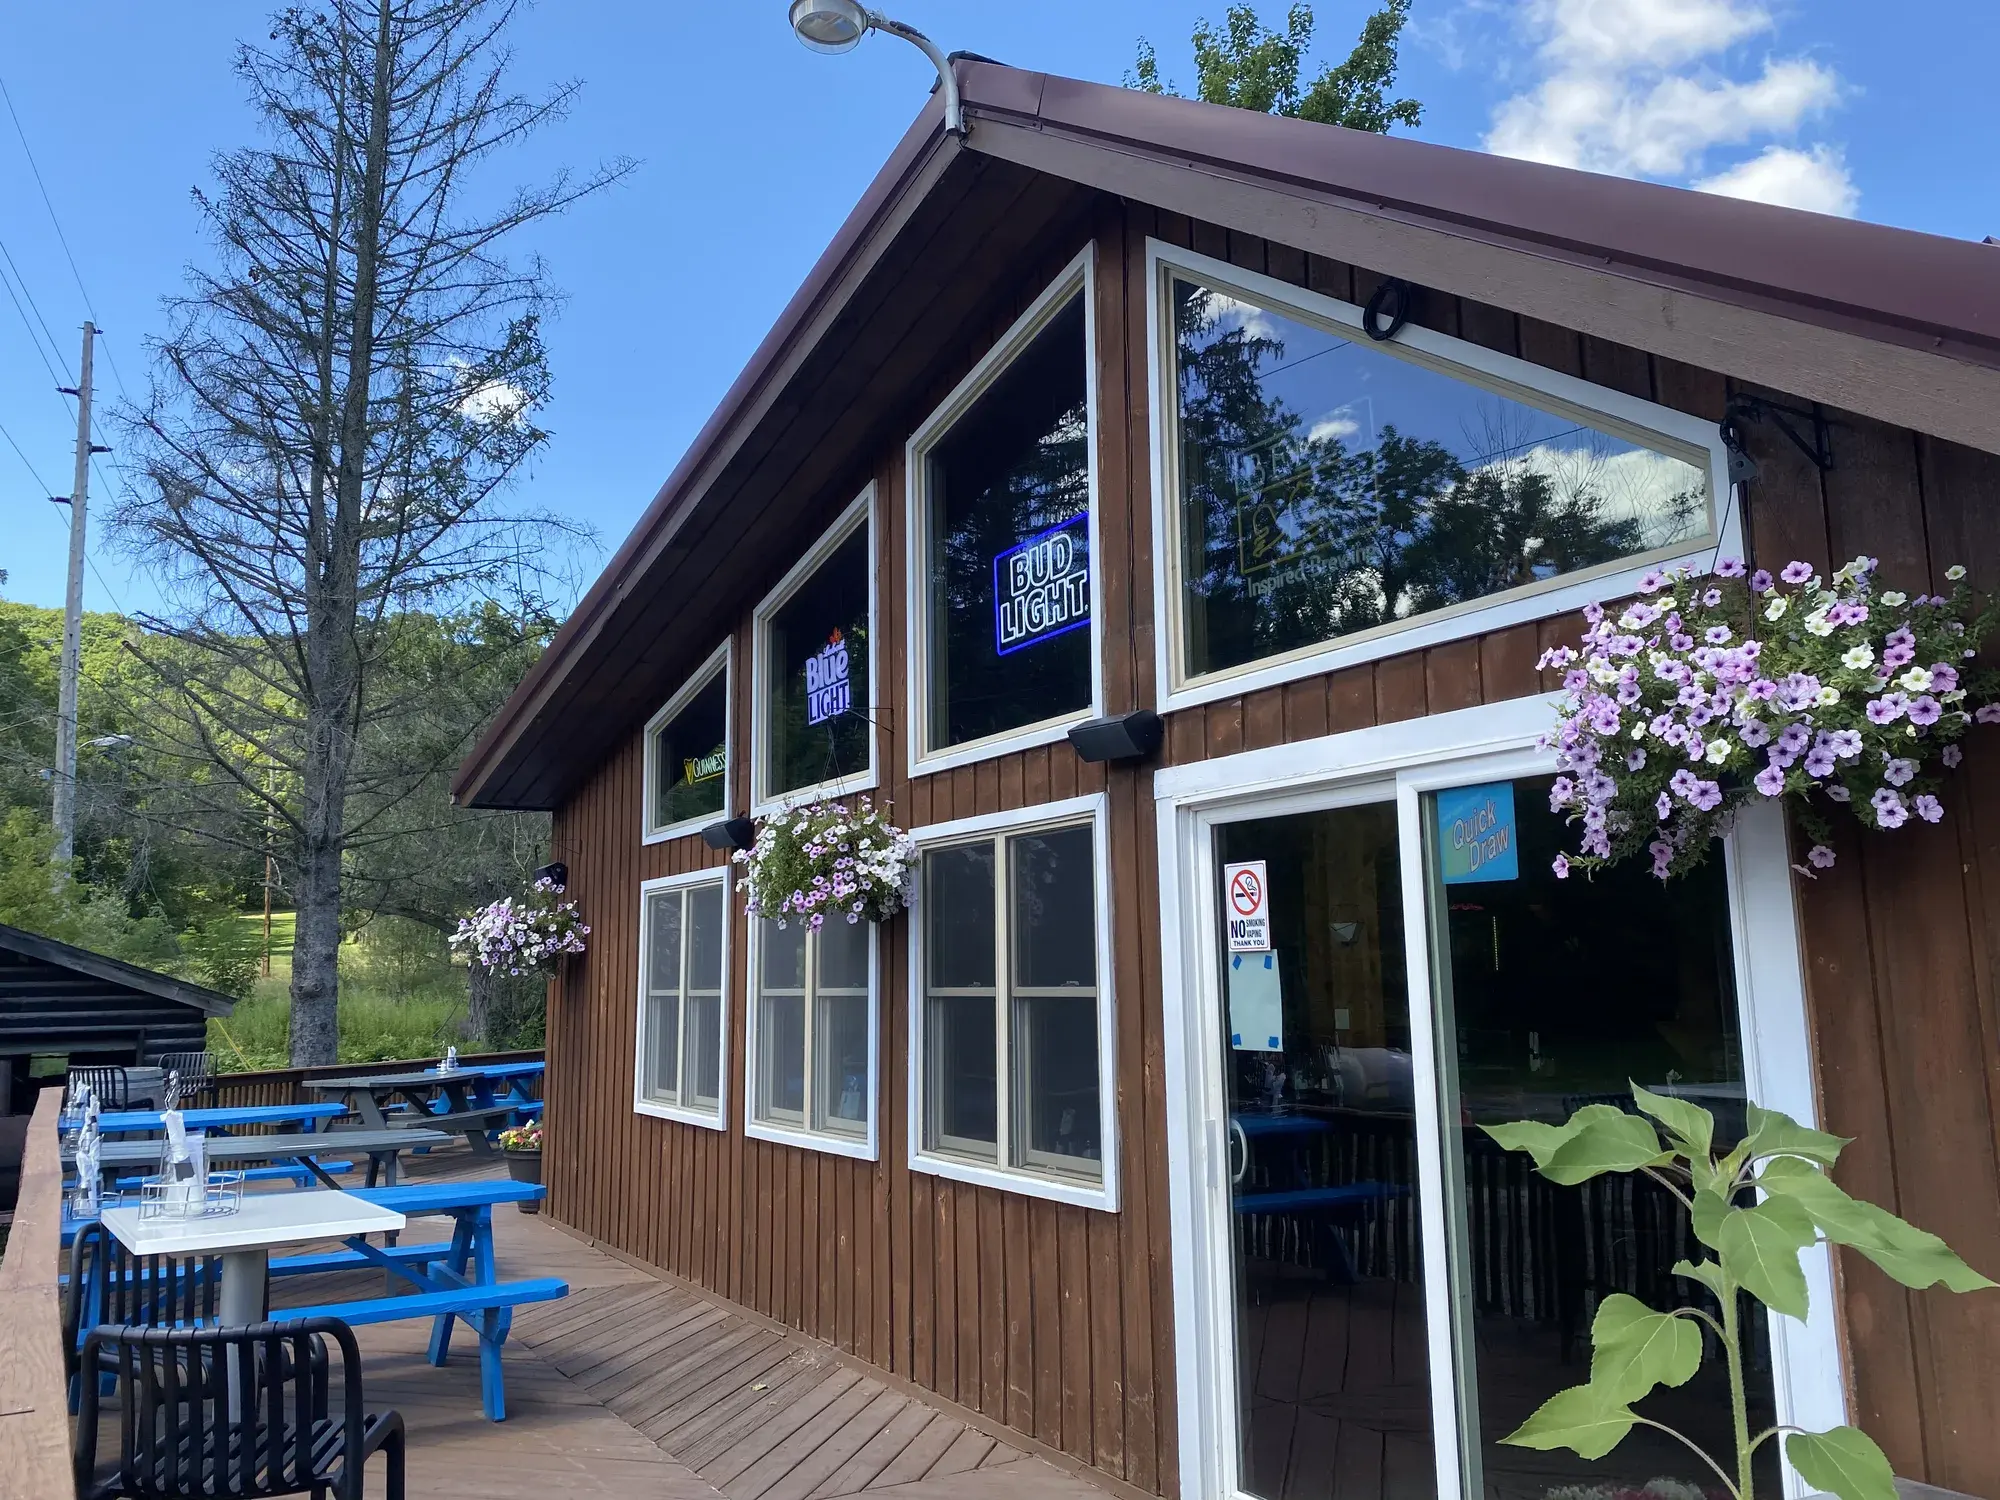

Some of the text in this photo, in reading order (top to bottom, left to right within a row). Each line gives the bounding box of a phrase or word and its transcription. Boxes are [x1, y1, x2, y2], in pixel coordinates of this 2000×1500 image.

[1010, 533, 1073, 597] BUD
[1247, 559, 1307, 598] Inspired
[805, 649, 850, 694] Blue
[1453, 798, 1497, 850] Quick
[1468, 824, 1509, 873] Draw
[1230, 919, 1246, 938] NO
[1246, 918, 1265, 927] SMOKING
[1246, 929, 1262, 938] VAPING
